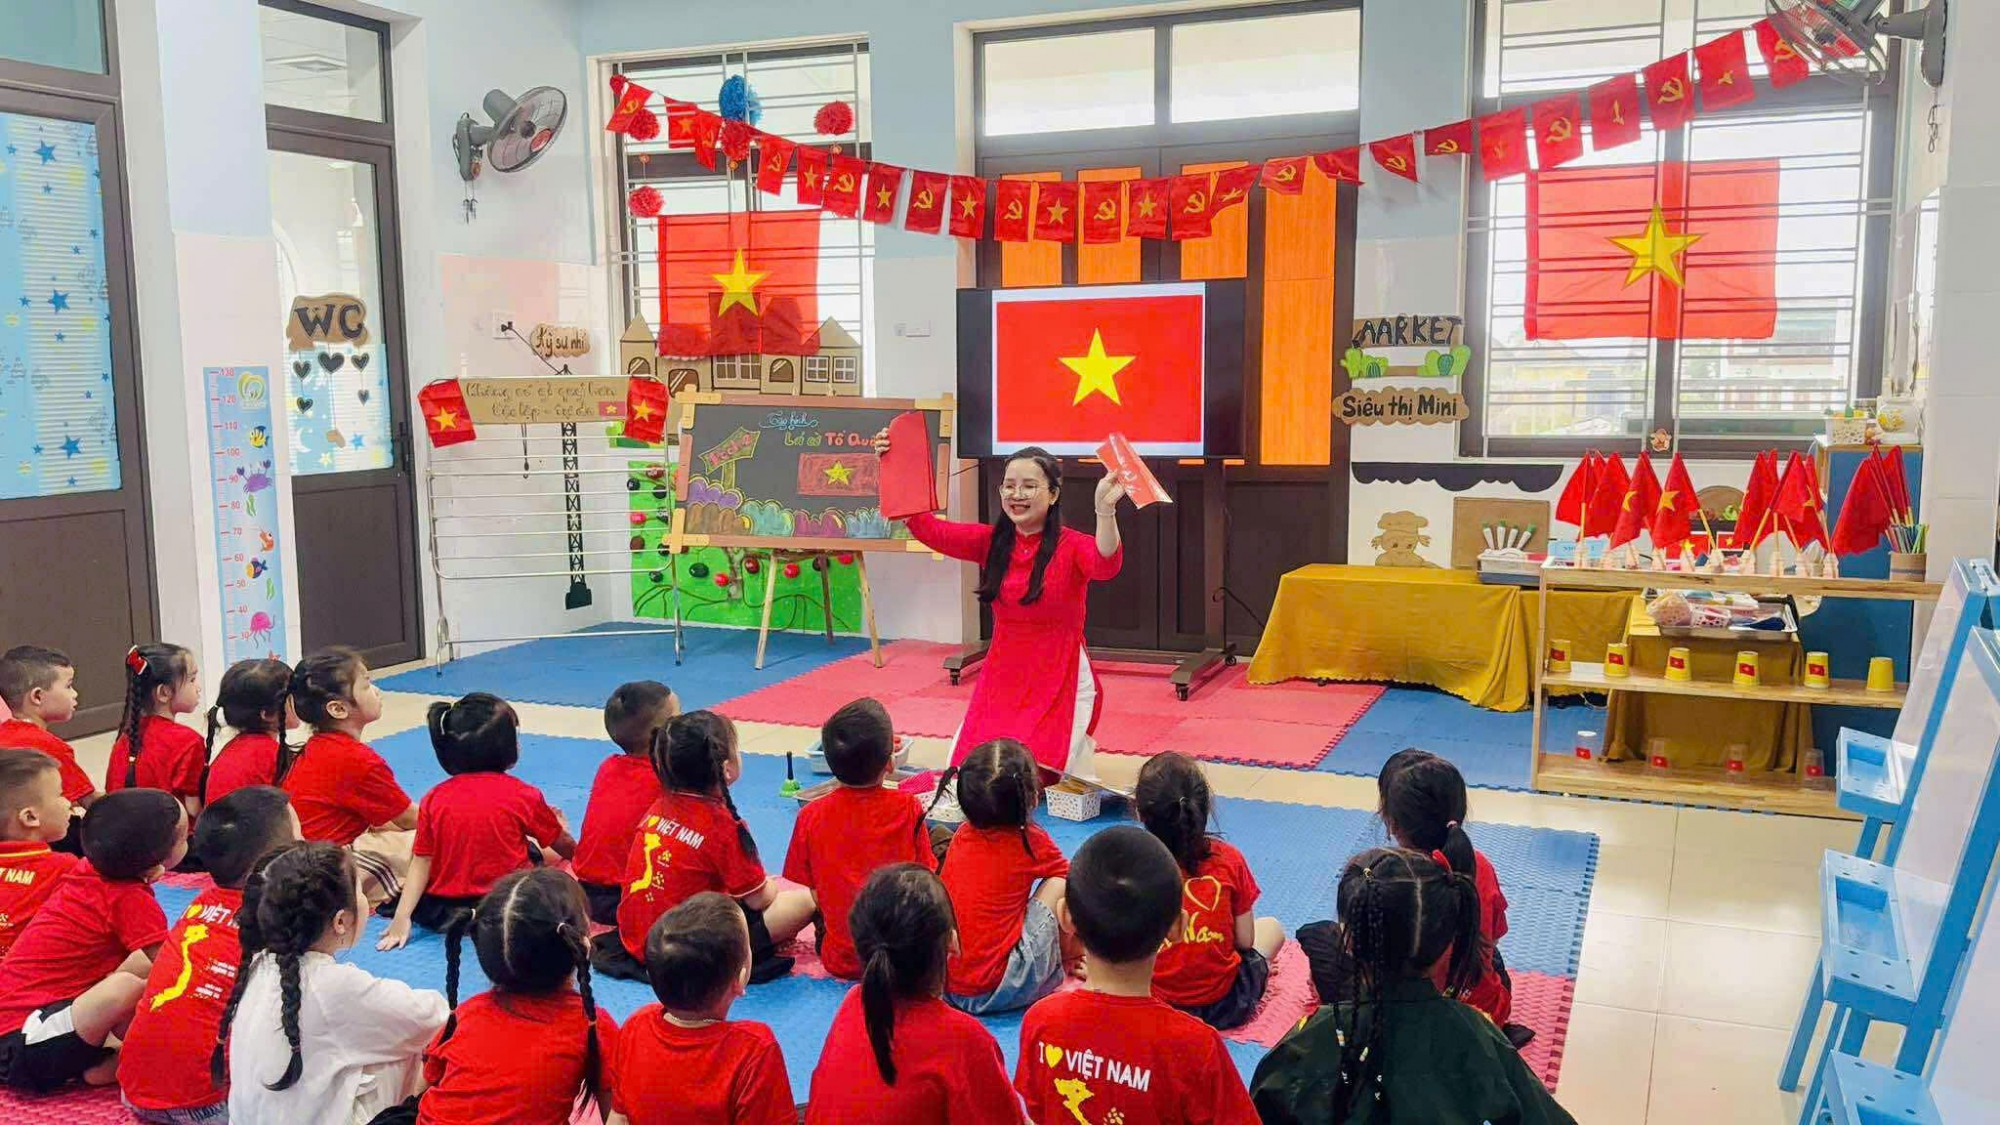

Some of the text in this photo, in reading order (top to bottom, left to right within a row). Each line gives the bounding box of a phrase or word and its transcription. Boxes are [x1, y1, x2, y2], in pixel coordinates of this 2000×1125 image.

[294, 304, 364, 338] WC
[223, 395, 236, 404] 120
[1343, 394, 1457, 420] Siêu thị Mini
[225, 421, 238, 430] 110
[825, 430, 846, 446] Tổ
[226, 448, 240, 457] 100
[229, 474, 239, 483] 90
[231, 500, 241, 510] 80
[233, 527, 243, 536] 70
[234, 553, 244, 562] 60
[236, 579, 246, 588] 50
[238, 605, 248, 613] 40
[675, 826, 705, 849] NAM
[5, 868, 36, 885] NAM
[199, 902, 232, 924] VIỆT
[1038, 1041, 1151, 1092] I VIỆT NAM
